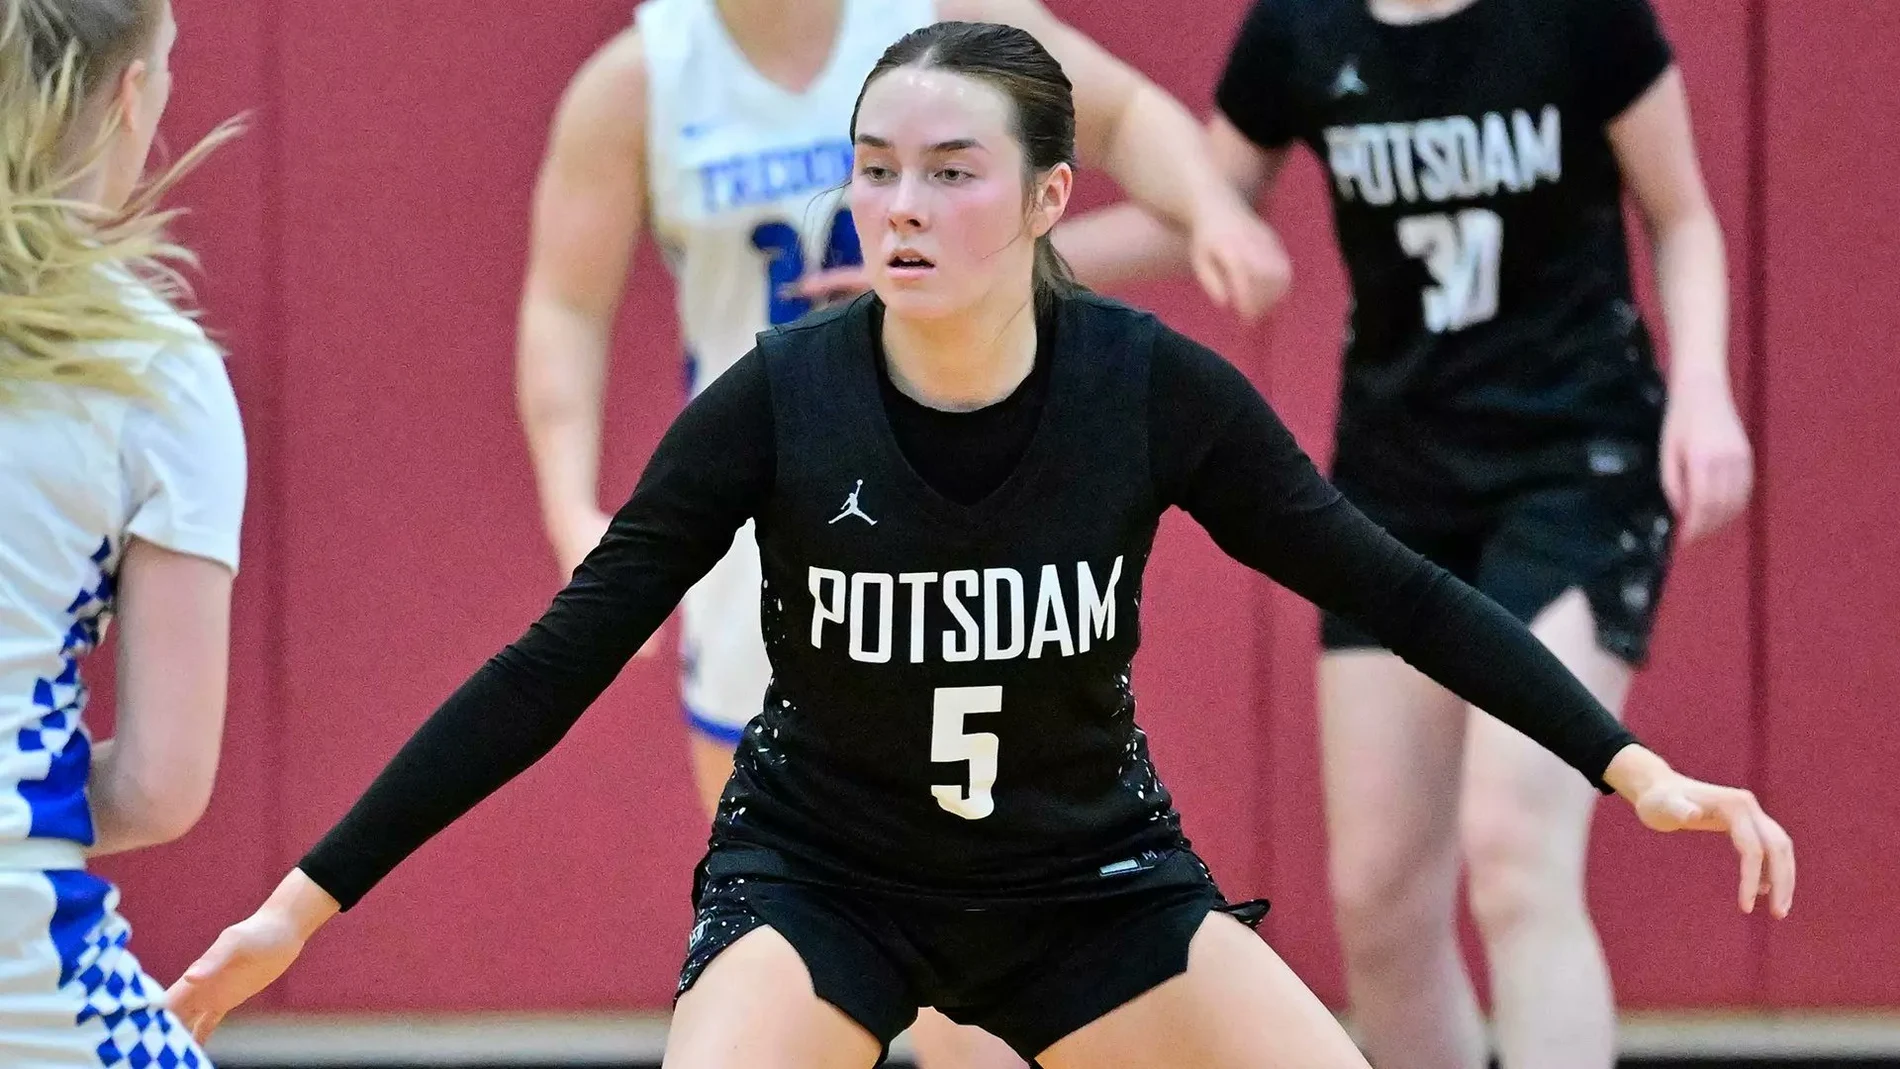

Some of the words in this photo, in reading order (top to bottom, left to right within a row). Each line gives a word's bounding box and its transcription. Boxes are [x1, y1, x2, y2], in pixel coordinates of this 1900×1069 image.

[1323, 103, 1561, 204] POTSDAM
[1397, 207, 1503, 333] 30
[808, 555, 1124, 664] POTSDAM
[930, 685, 1003, 820] 5
